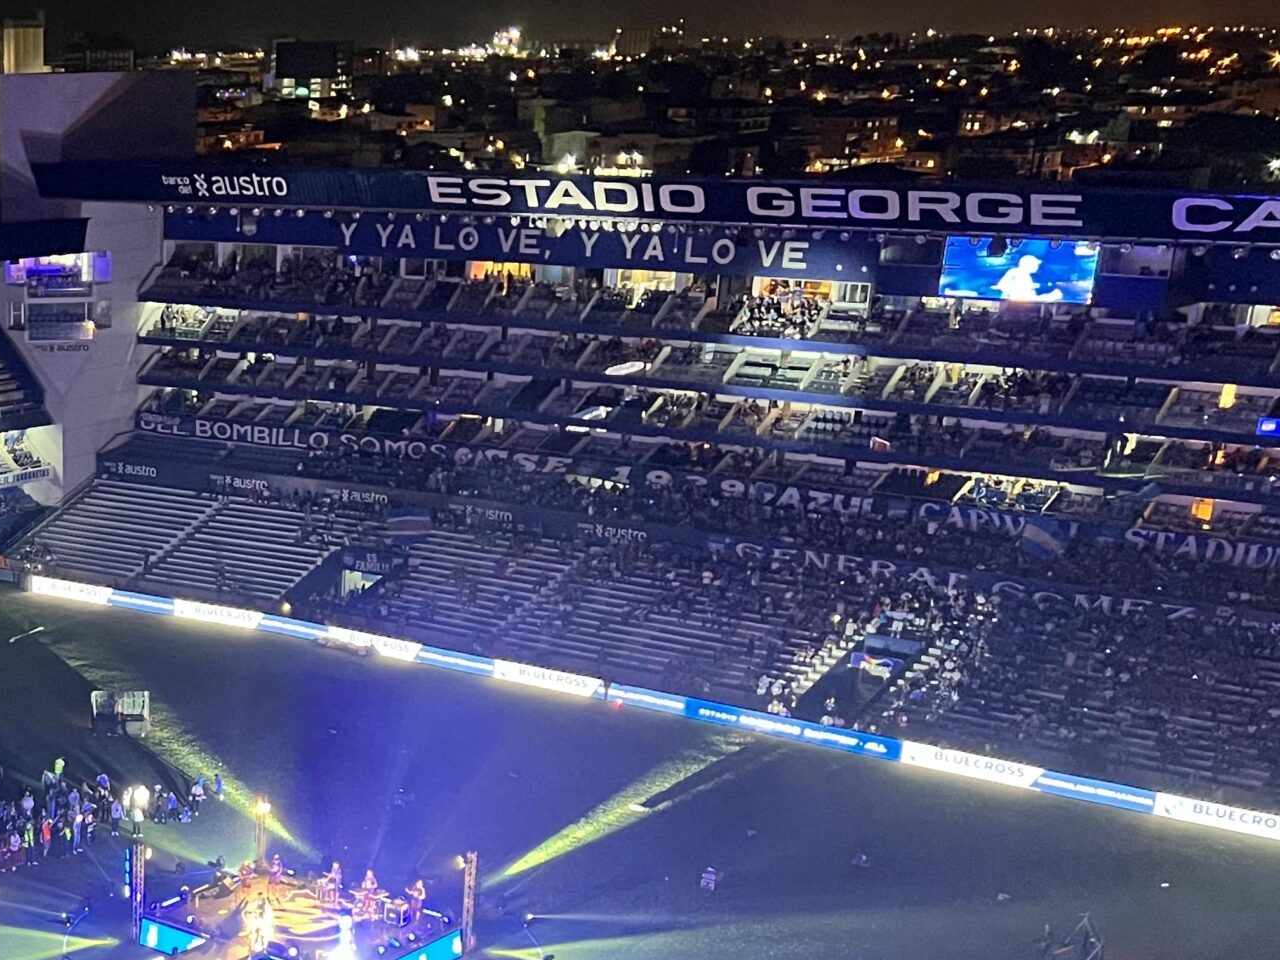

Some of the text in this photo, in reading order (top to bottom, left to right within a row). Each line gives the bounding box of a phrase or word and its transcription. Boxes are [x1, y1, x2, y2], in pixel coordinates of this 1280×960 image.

[161, 174, 191, 187] banco
[178, 183, 193, 195] del
[212, 174, 288, 197] austro
[427, 175, 705, 215] ESTADIO
[747, 186, 1083, 227] GEORGE
[340, 223, 358, 246] Y
[376, 224, 416, 249] YA
[434, 226, 479, 251] LO
[580, 232, 600, 257] Y
[620, 233, 664, 261] YA
[684, 236, 736, 264] LO
[758, 240, 809, 269] VE
[195, 419, 329, 450] BOMBILLO
[124, 463, 157, 478] austro
[233, 477, 268, 490] austro
[350, 490, 388, 505] austro
[604, 525, 647, 542] austro
[519, 667, 588, 689] BLUECROSS
[934, 751, 1025, 779] BLUECROSS
